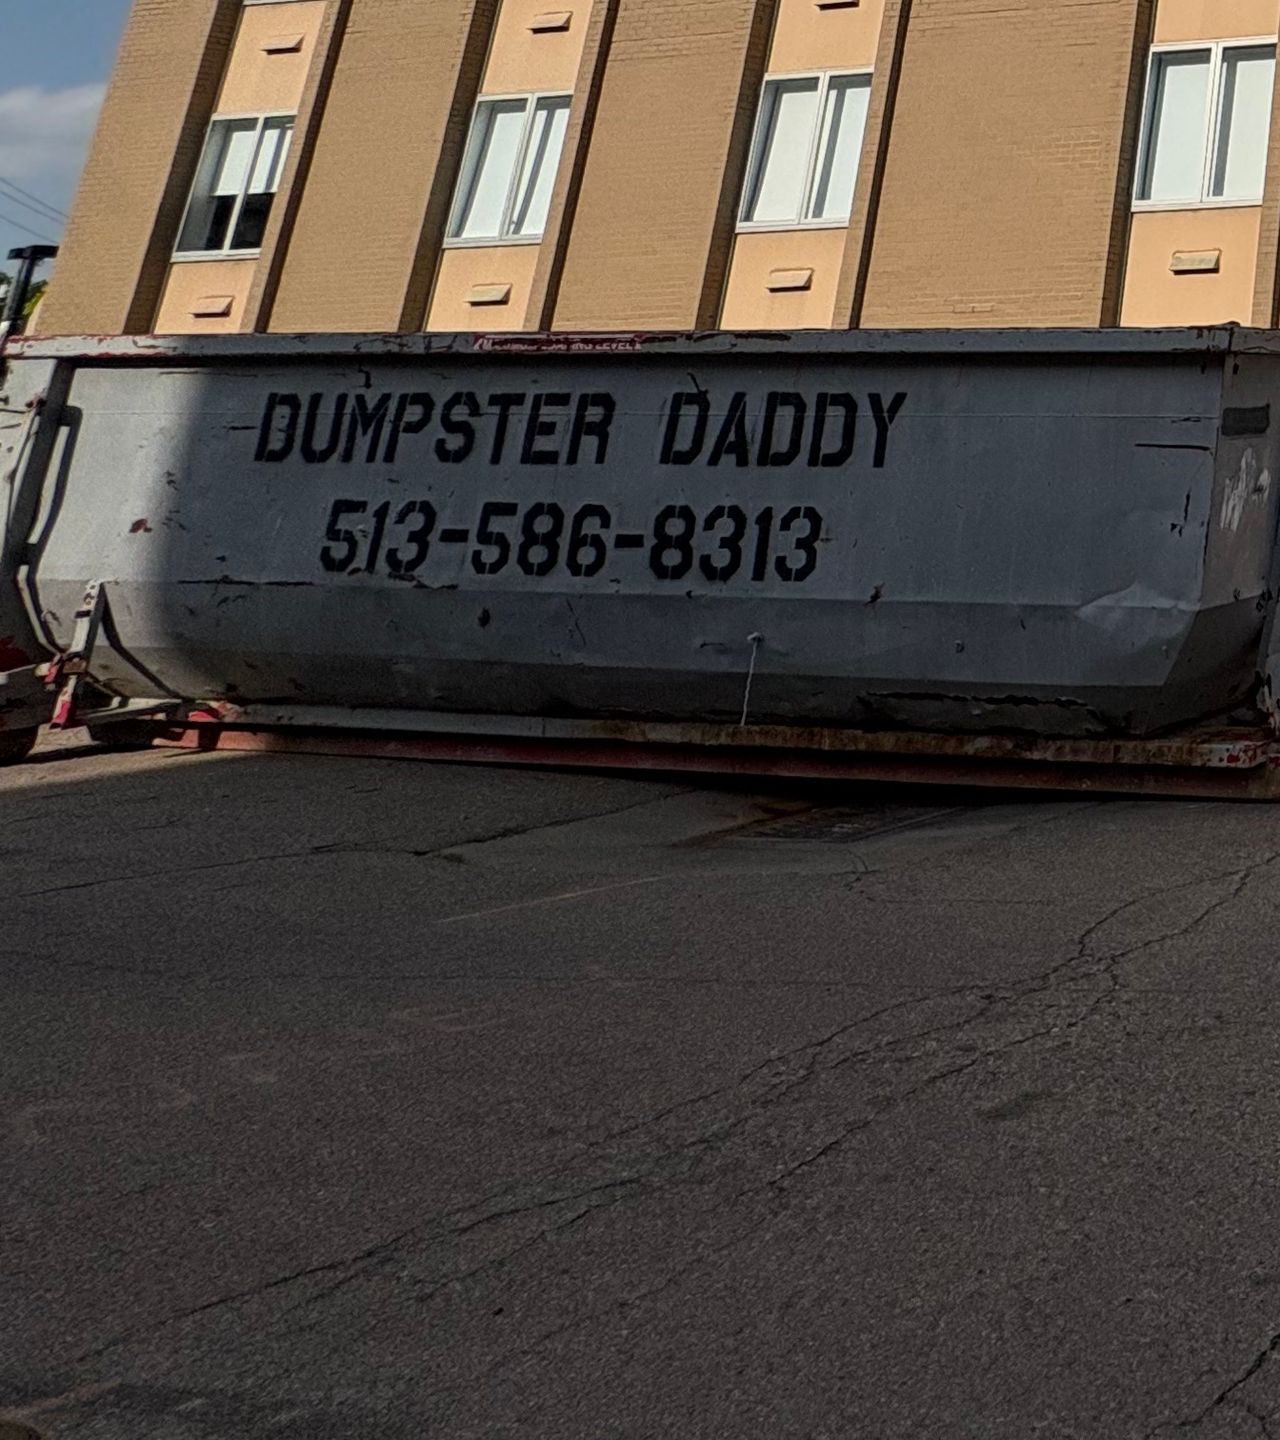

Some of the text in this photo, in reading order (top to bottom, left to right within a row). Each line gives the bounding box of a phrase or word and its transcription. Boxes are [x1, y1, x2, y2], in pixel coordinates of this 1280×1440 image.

[253, 391, 907, 467] DUMPSTER DADDY
[320, 499, 823, 582] 513-586-8313
